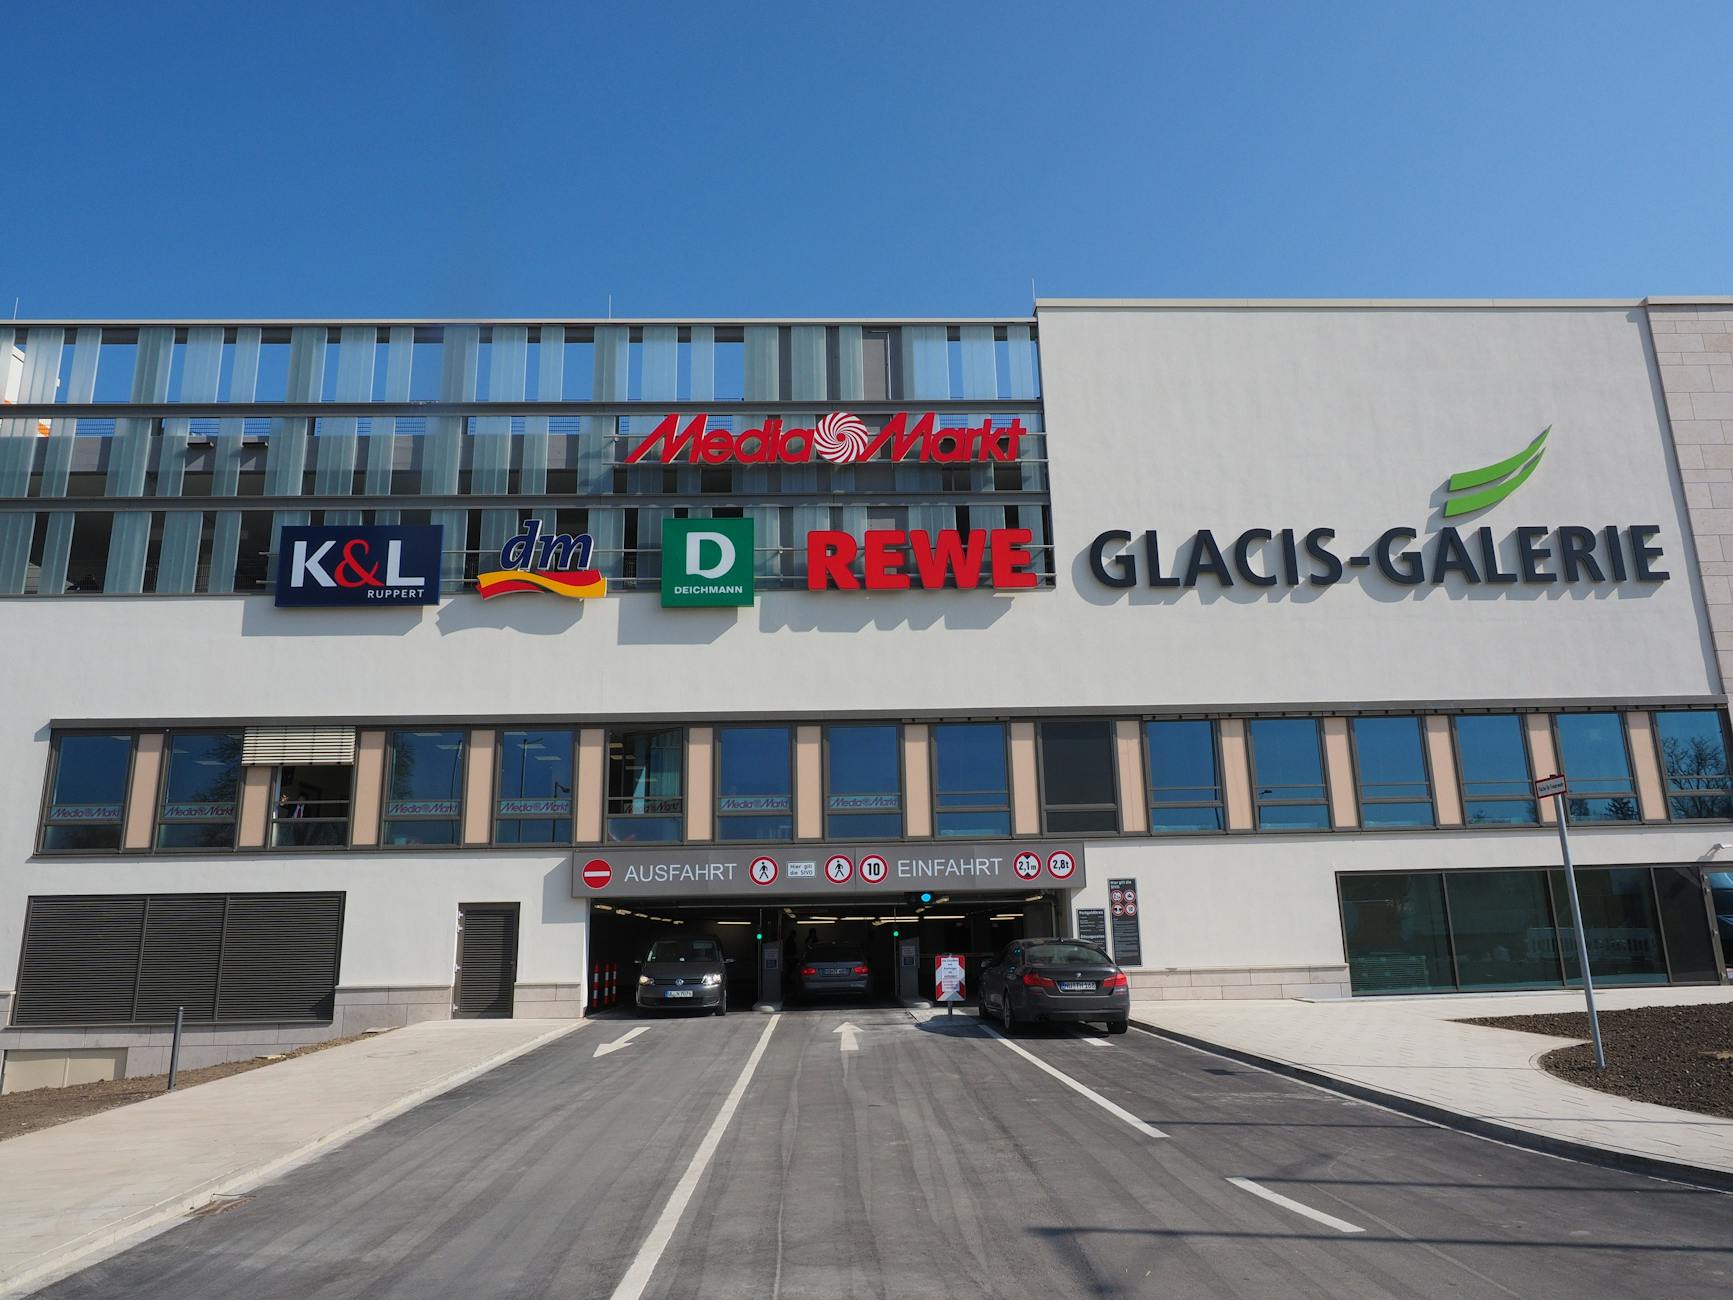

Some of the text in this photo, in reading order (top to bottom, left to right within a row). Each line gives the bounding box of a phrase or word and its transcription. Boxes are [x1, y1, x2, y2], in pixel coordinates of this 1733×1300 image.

[624, 412, 1026, 464] Media Markt
[290, 539, 425, 588] K&L
[500, 519, 594, 571] dm
[686, 531, 736, 579] D
[807, 528, 1038, 590] REWE
[1089, 524, 1671, 588] GLACIS-GALERIE
[367, 589, 425, 599] RUPPERT
[674, 585, 744, 595] DEICHMANN
[624, 863, 737, 882] AUSFAHRT
[867, 862, 880, 876] 10
[898, 858, 1003, 877] EINFAHRT
